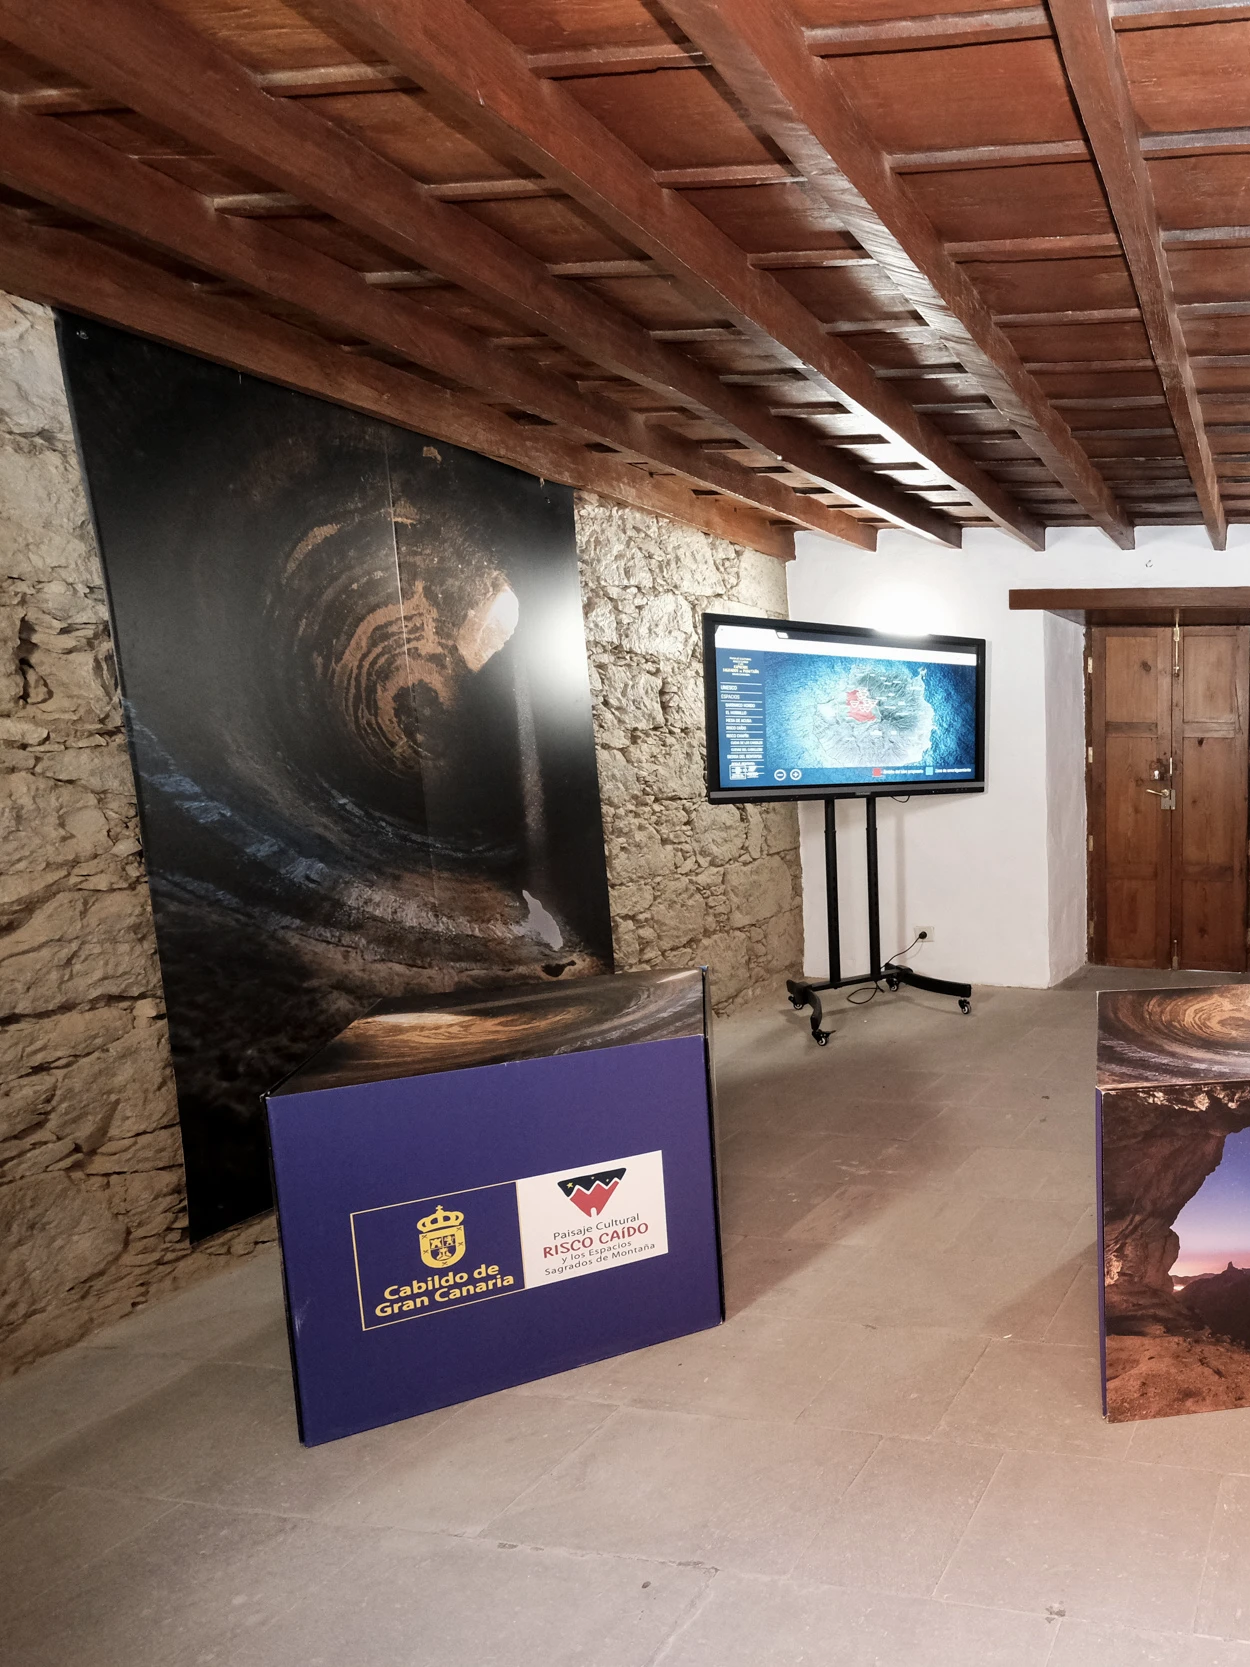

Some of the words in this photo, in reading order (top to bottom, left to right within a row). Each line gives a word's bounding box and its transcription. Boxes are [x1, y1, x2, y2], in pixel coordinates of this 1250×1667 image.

[543, 1236, 594, 1259] RISCO
[598, 1222, 649, 1245] CAÍDO
[553, 1225, 593, 1241] Paisaje
[595, 1213, 640, 1231] Cultural
[544, 1259, 593, 1276] Sagrados
[595, 1254, 609, 1263] de
[611, 1242, 656, 1260] Montaña
[561, 1256, 568, 1264] y
[570, 1251, 586, 1261] los
[588, 1241, 632, 1257] Espacios
[374, 1295, 429, 1317] Gran
[434, 1274, 515, 1302] Canaria
[383, 1271, 469, 1300] Cabildo
[473, 1263, 500, 1279] de
